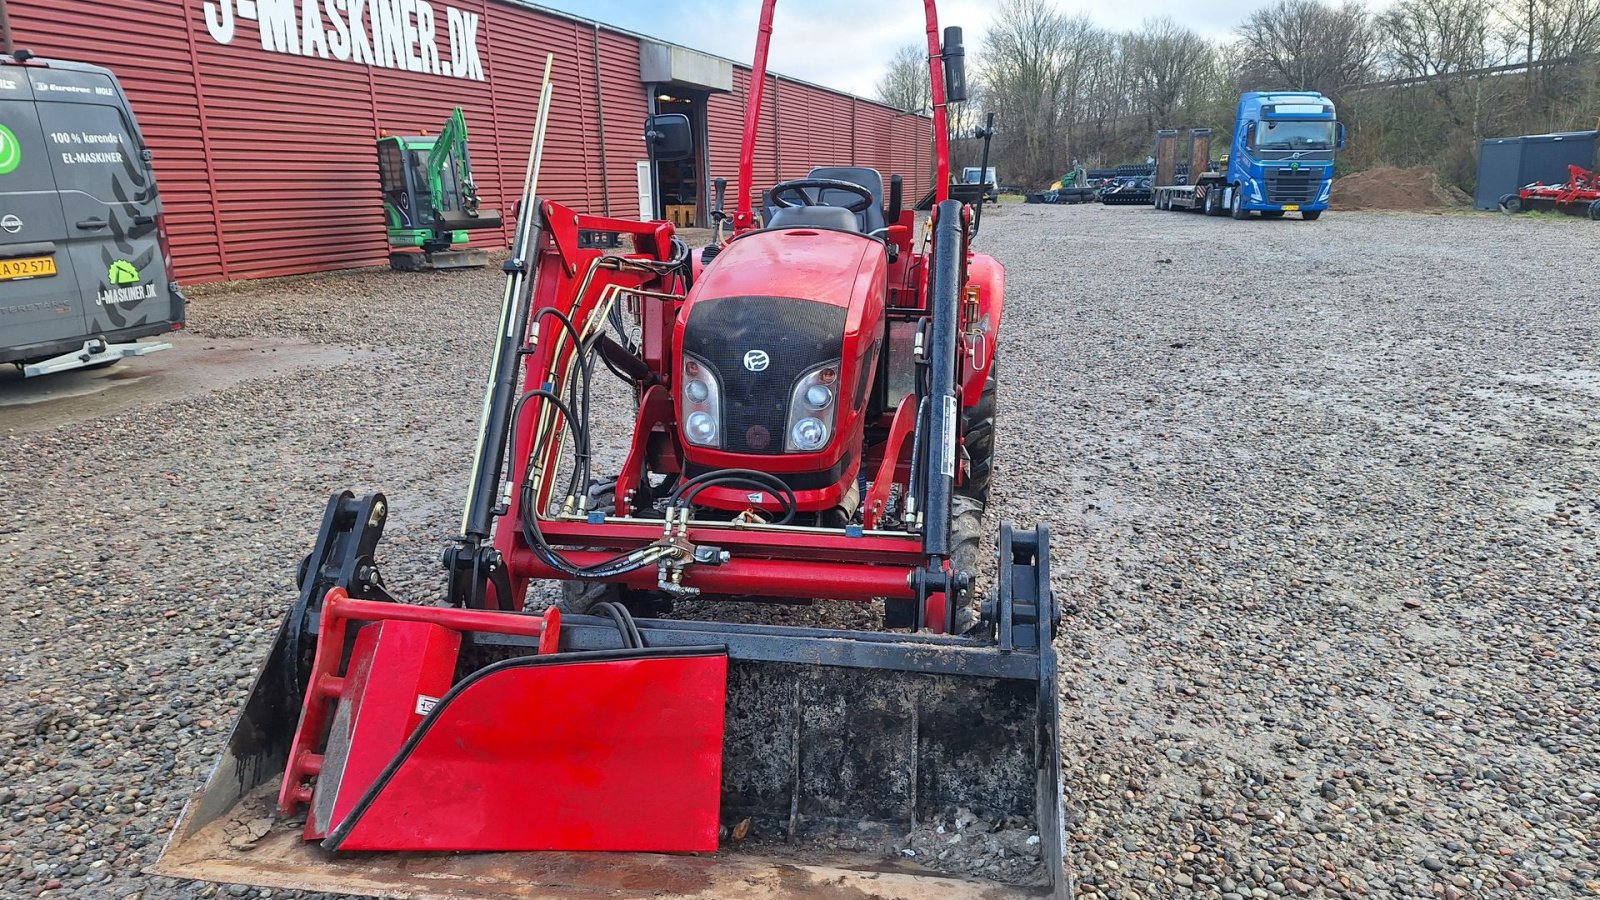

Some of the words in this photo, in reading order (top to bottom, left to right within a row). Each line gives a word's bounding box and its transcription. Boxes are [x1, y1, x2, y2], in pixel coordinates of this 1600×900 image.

[203, 0, 486, 82] J-MASKINER.DK
[51, 132, 70, 144] 100
[71, 133, 81, 144] %
[62, 152, 123, 163] EL-MASKINER
[0, 263, 11, 276] A
[31, 259, 51, 273] 577
